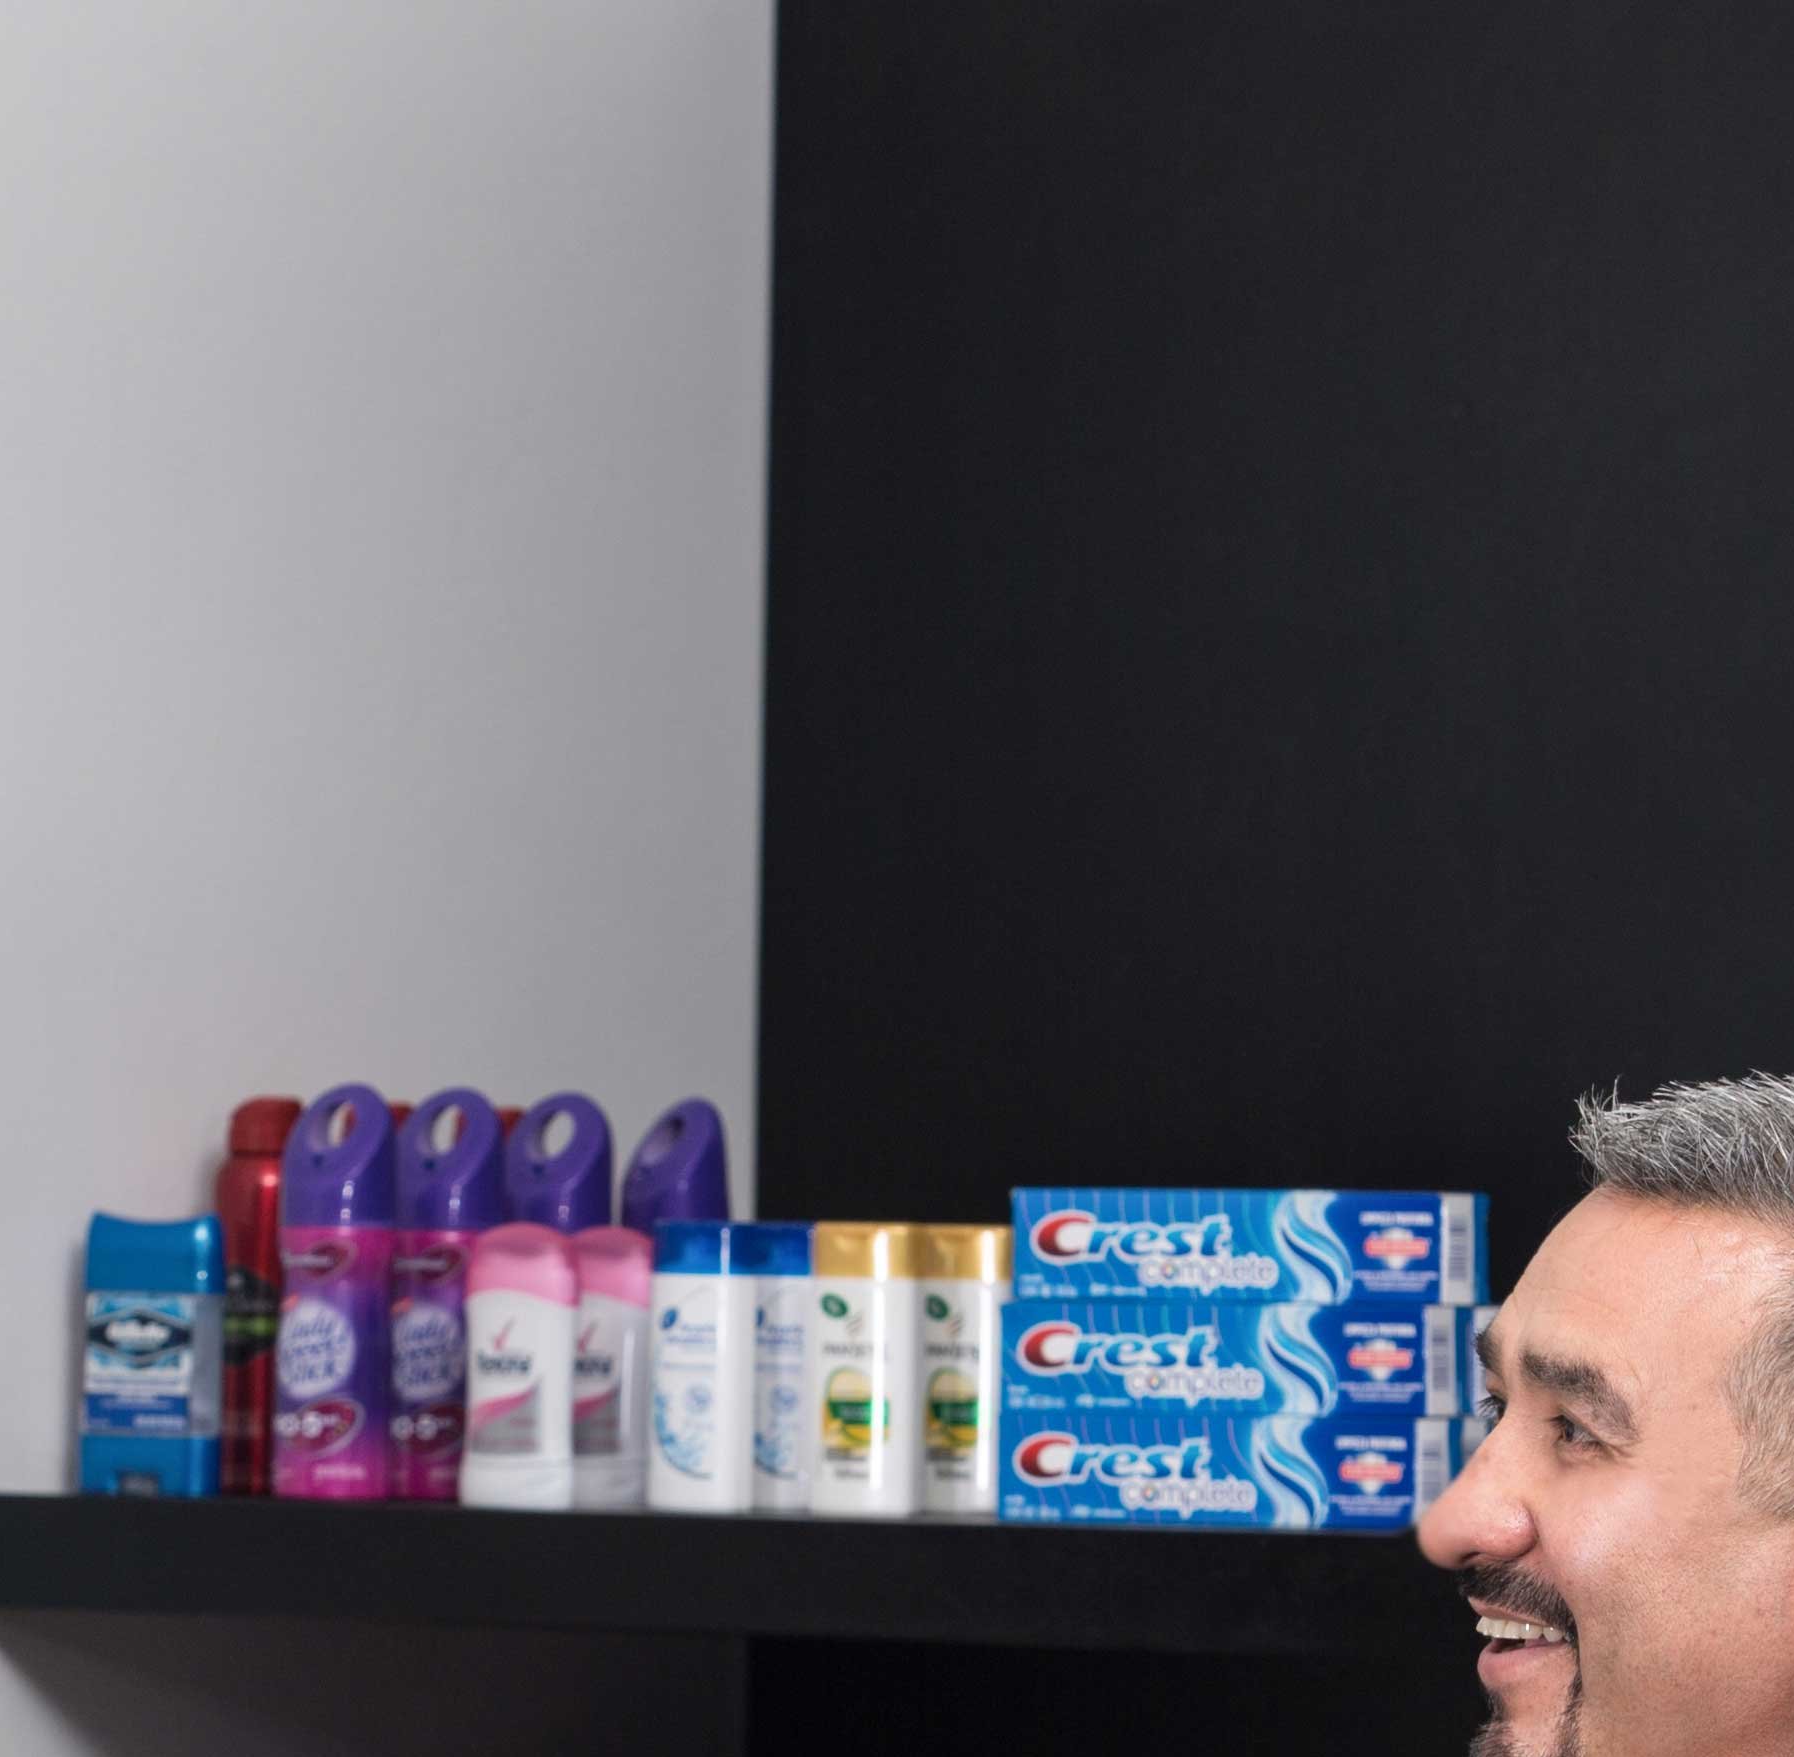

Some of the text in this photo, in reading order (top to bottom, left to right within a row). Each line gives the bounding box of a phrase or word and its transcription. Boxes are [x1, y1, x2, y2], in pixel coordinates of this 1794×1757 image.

[1034, 1212, 1232, 1264] Crest
[1141, 1253, 1277, 1294] complete
[1019, 1322, 1217, 1375] Crest
[1126, 1365, 1262, 1405] complete
[1014, 1433, 1210, 1485] Crest
[1121, 1477, 1256, 1518] complete
